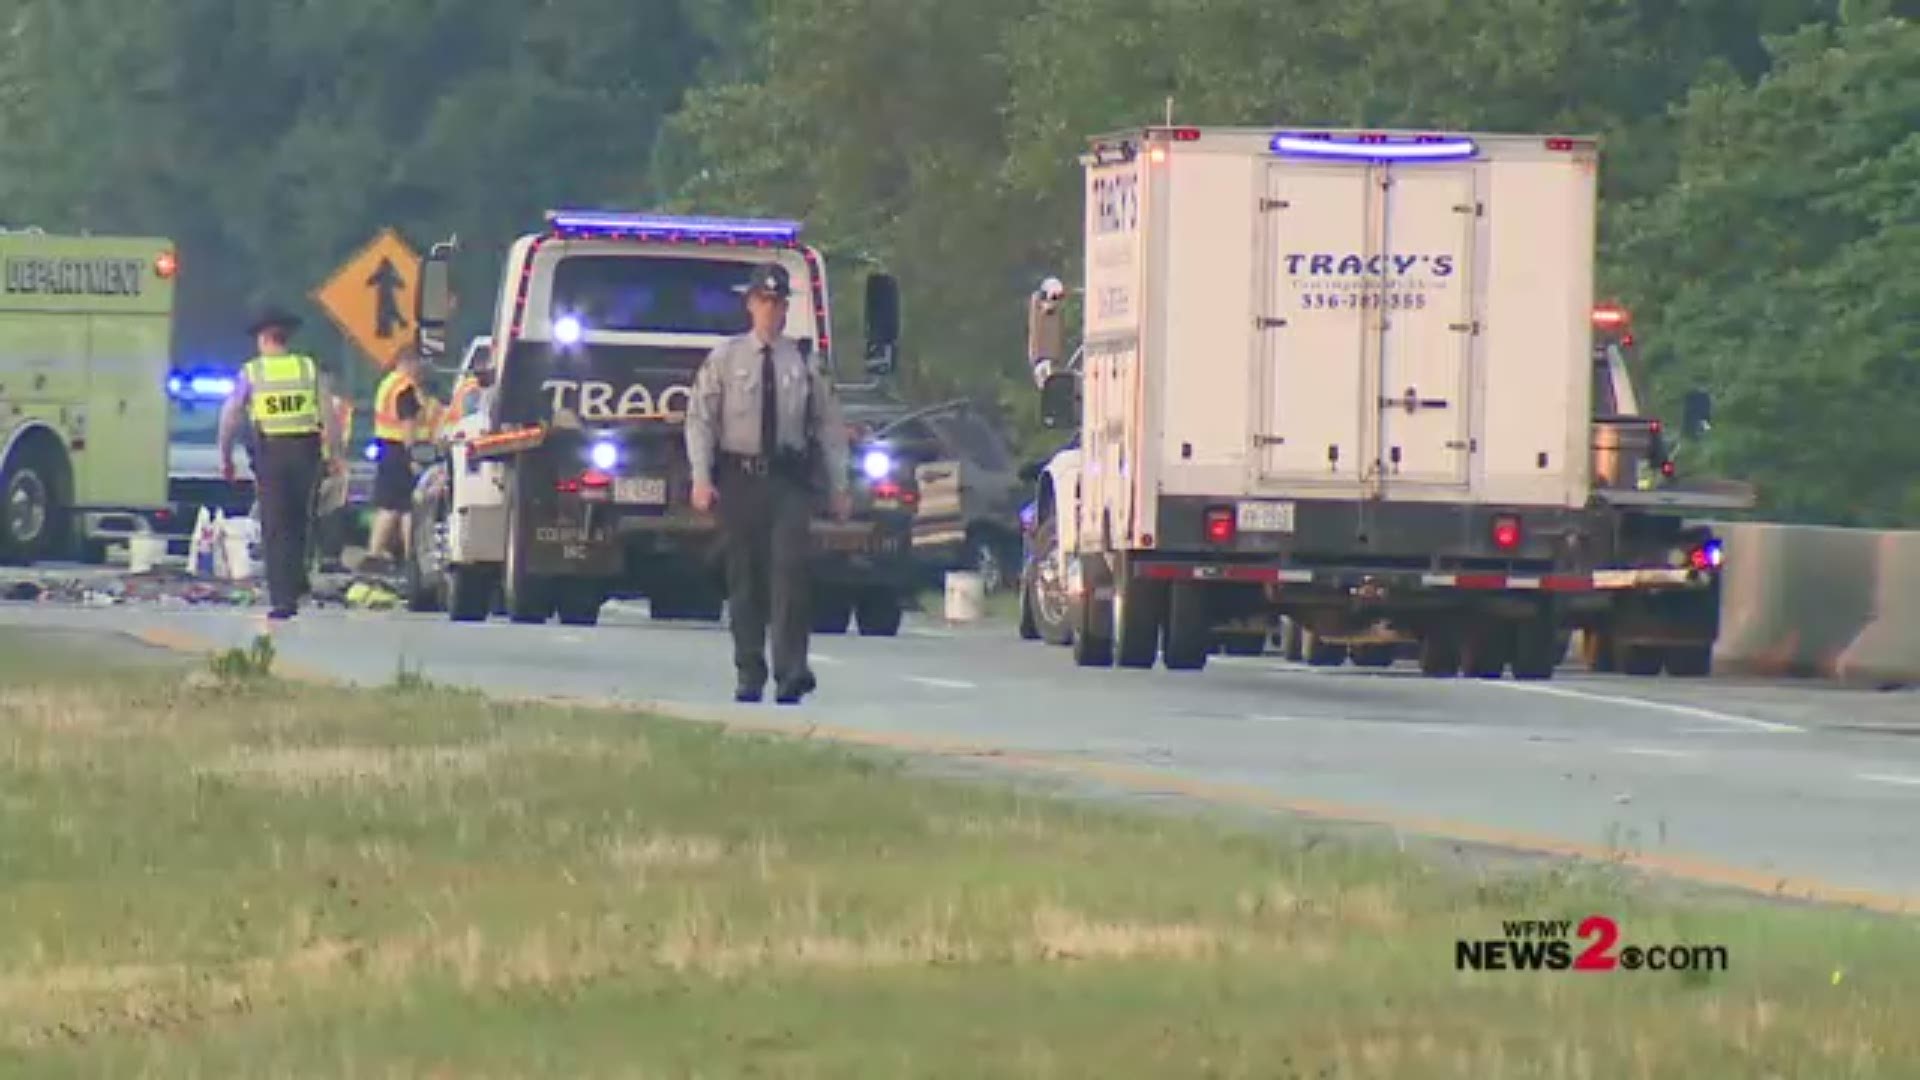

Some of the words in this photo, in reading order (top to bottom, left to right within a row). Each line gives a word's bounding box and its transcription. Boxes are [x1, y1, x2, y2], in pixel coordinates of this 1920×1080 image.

[6, 258, 143, 296] DEPARTMENT
[1284, 254, 1454, 277] TRACY'S
[265, 395, 307, 415] SHP
